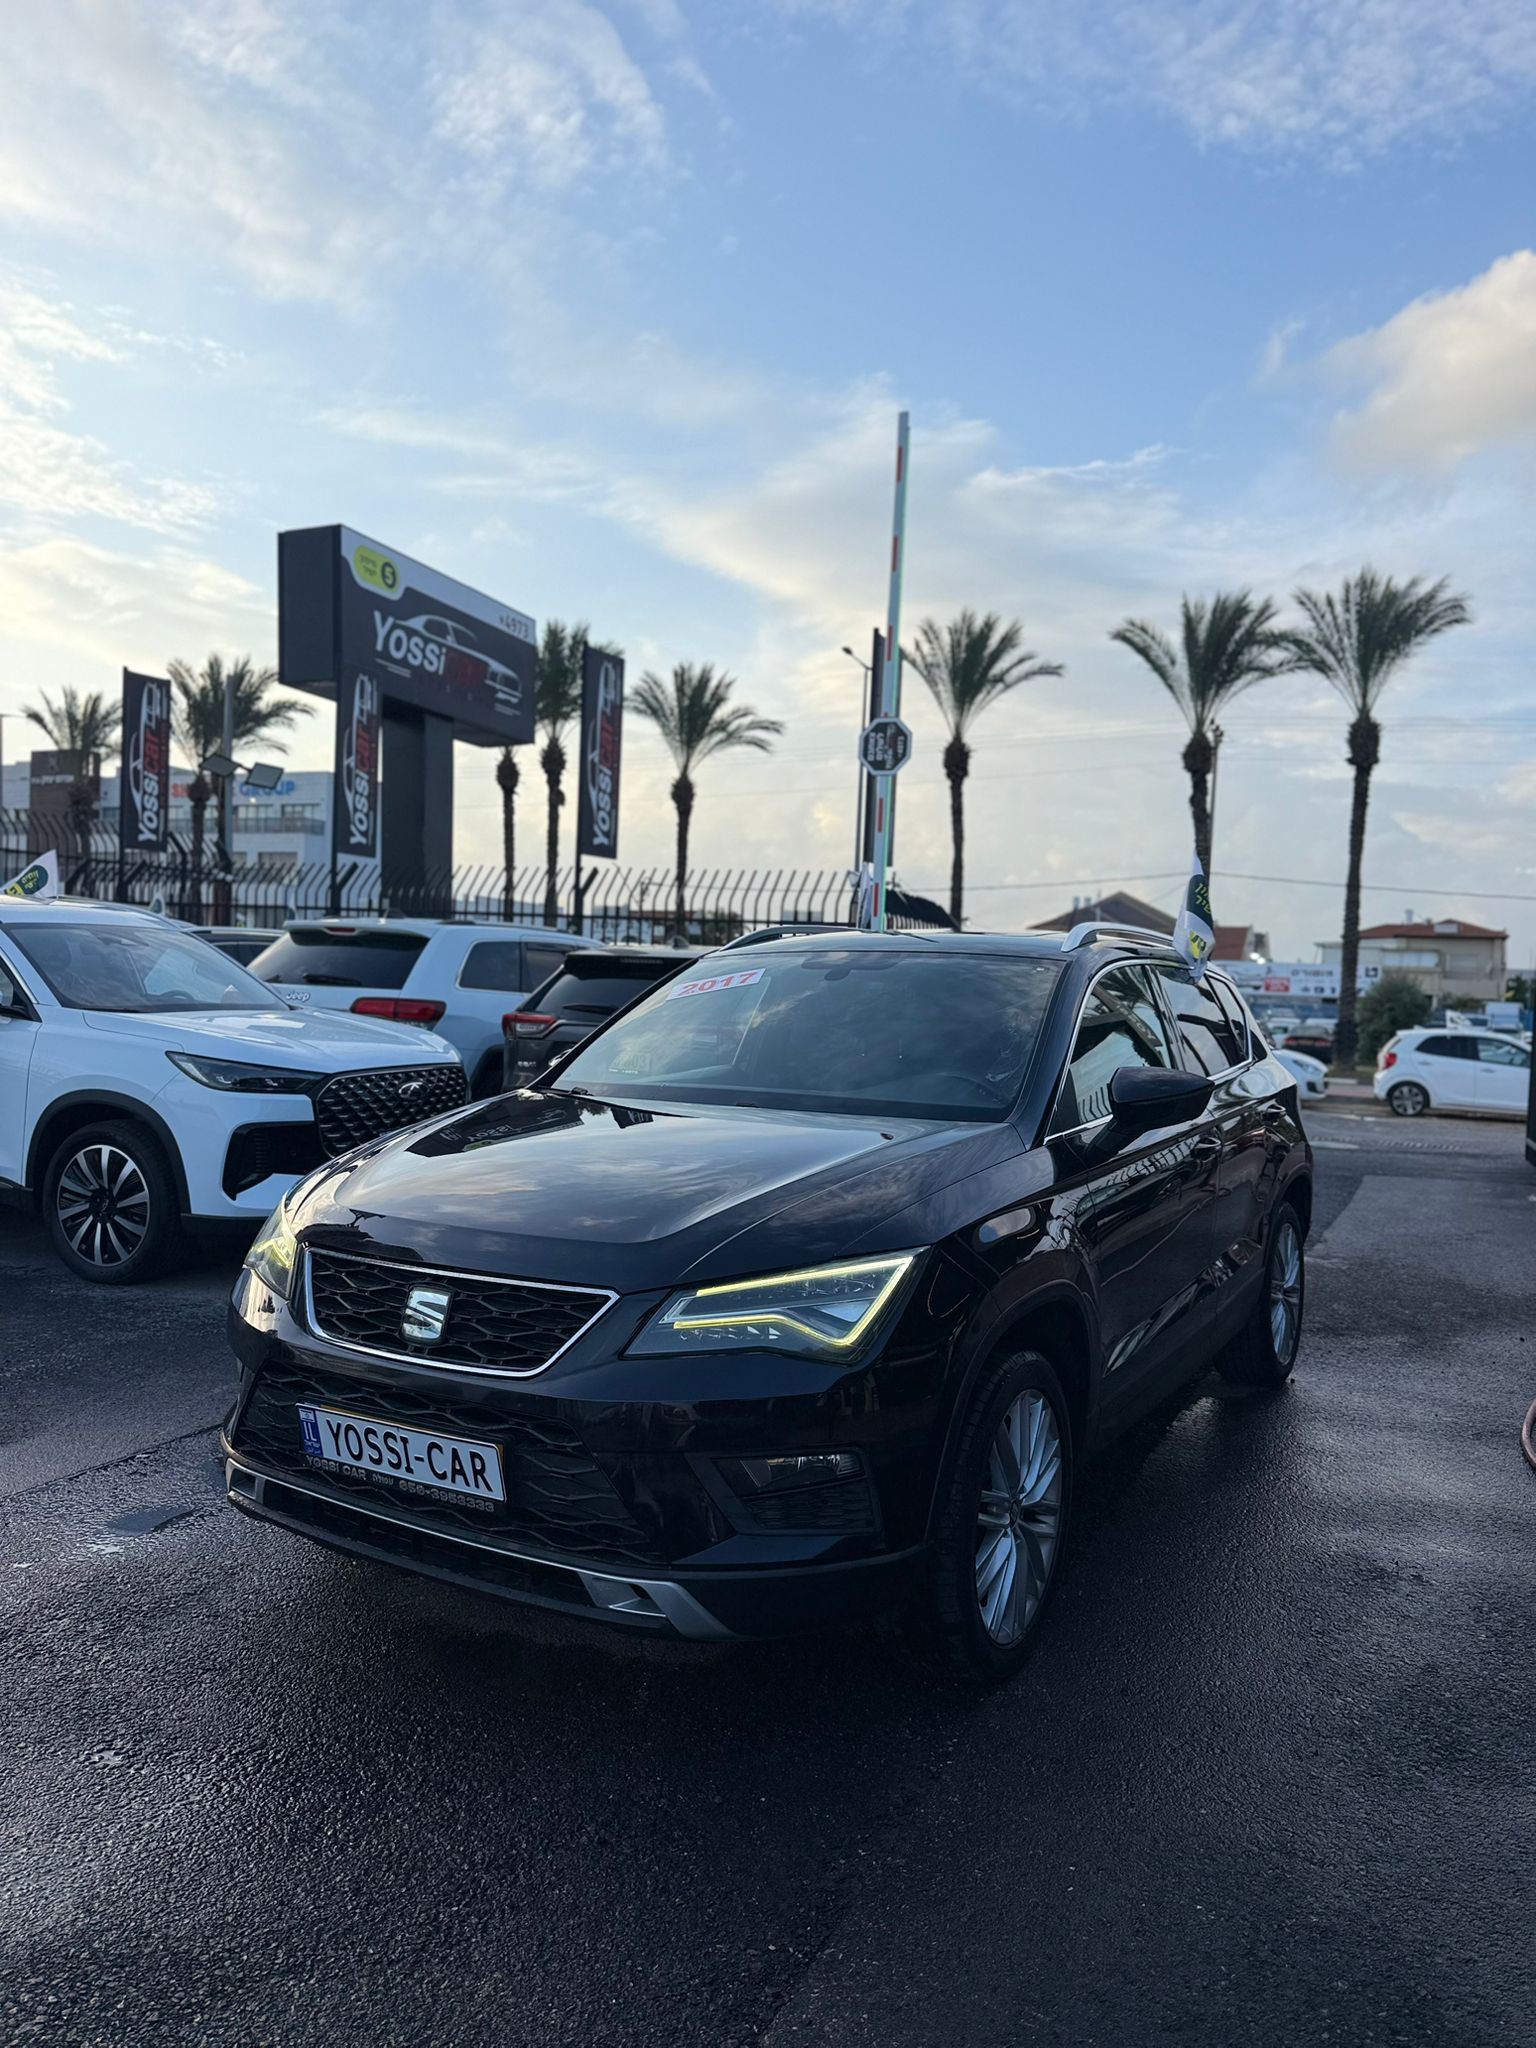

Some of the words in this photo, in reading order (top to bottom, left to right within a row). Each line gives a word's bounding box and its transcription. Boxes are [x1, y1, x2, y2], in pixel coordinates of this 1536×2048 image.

[678, 971, 759, 996] 2017
[285, 990, 311, 1002] Jeep
[303, 1421, 318, 1442] IL
[326, 1418, 493, 1492] YOSSI-CAR
[343, 1466, 367, 1480] CAR
